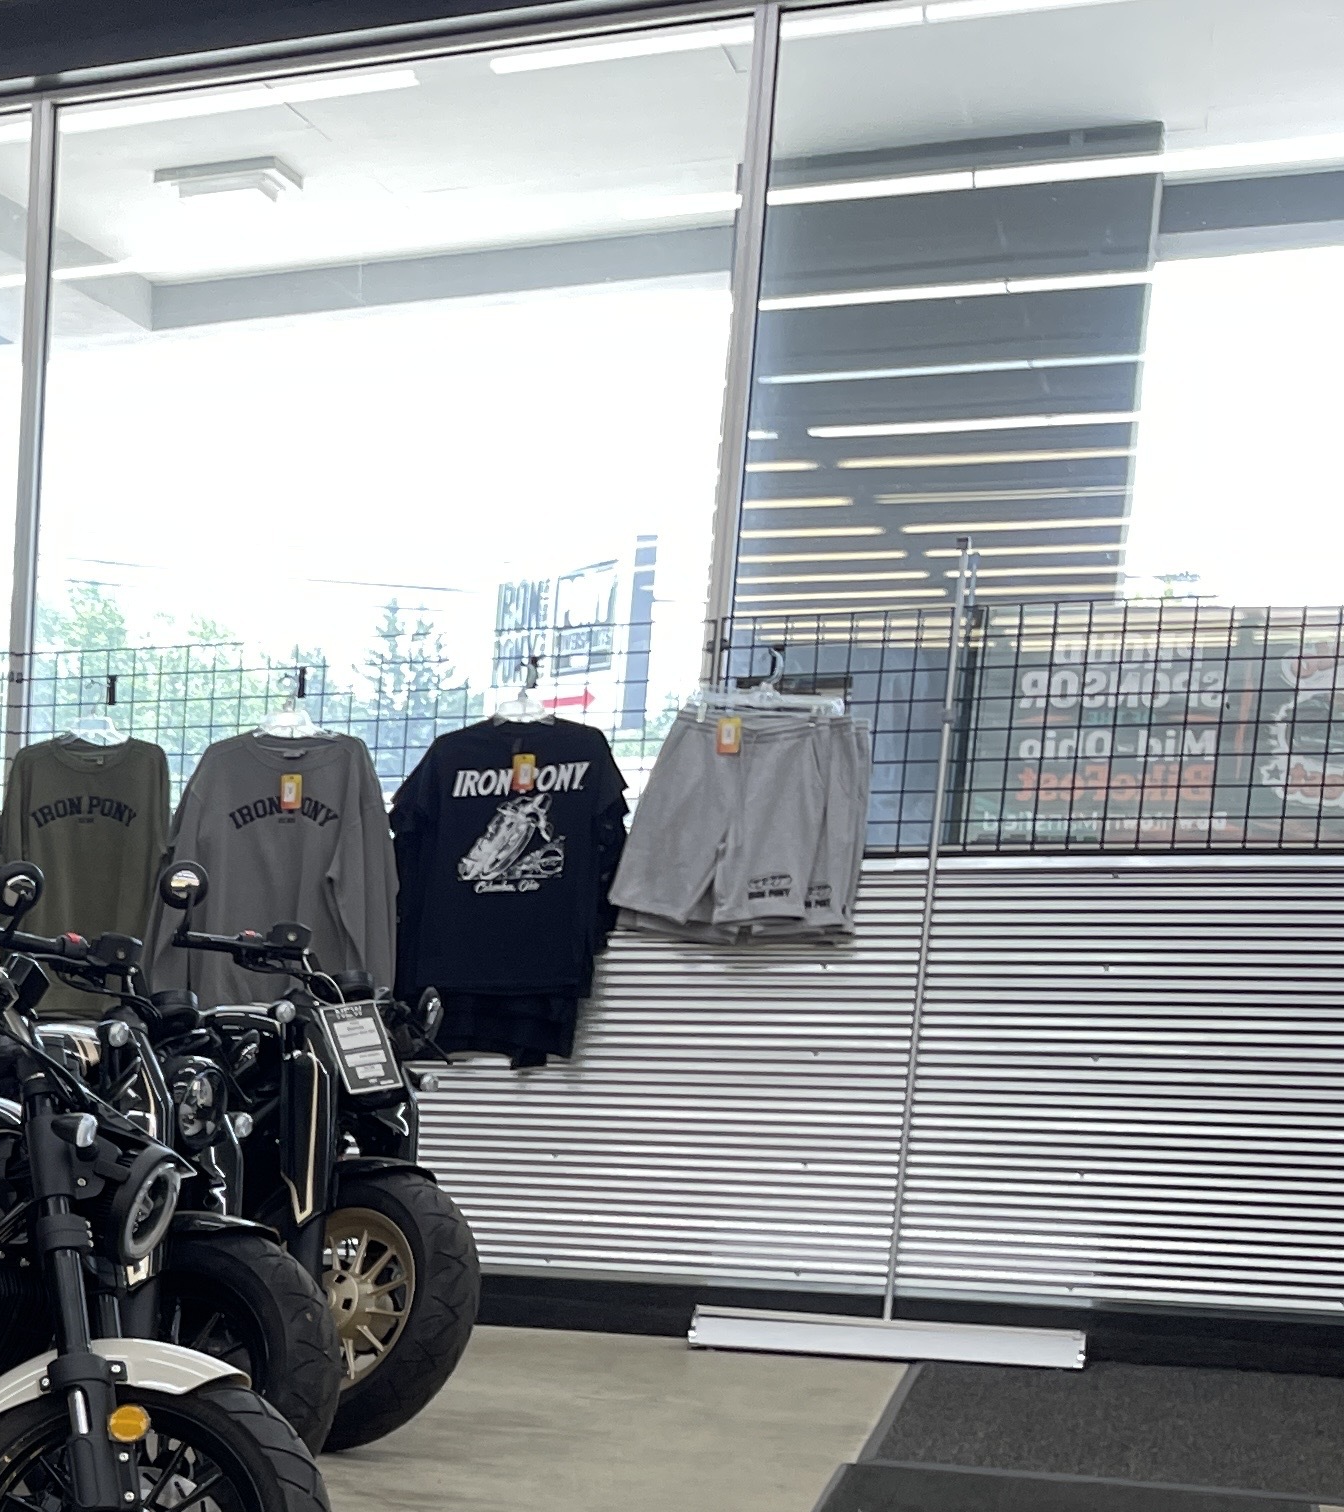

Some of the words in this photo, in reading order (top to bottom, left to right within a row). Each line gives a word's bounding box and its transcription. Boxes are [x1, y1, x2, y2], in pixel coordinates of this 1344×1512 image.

[452, 769, 514, 798] IRON
[31, 796, 83, 829] IRON
[88, 796, 137, 827] PONY
[229, 796, 283, 829] IRON
[288, 797, 339, 827] ONY
